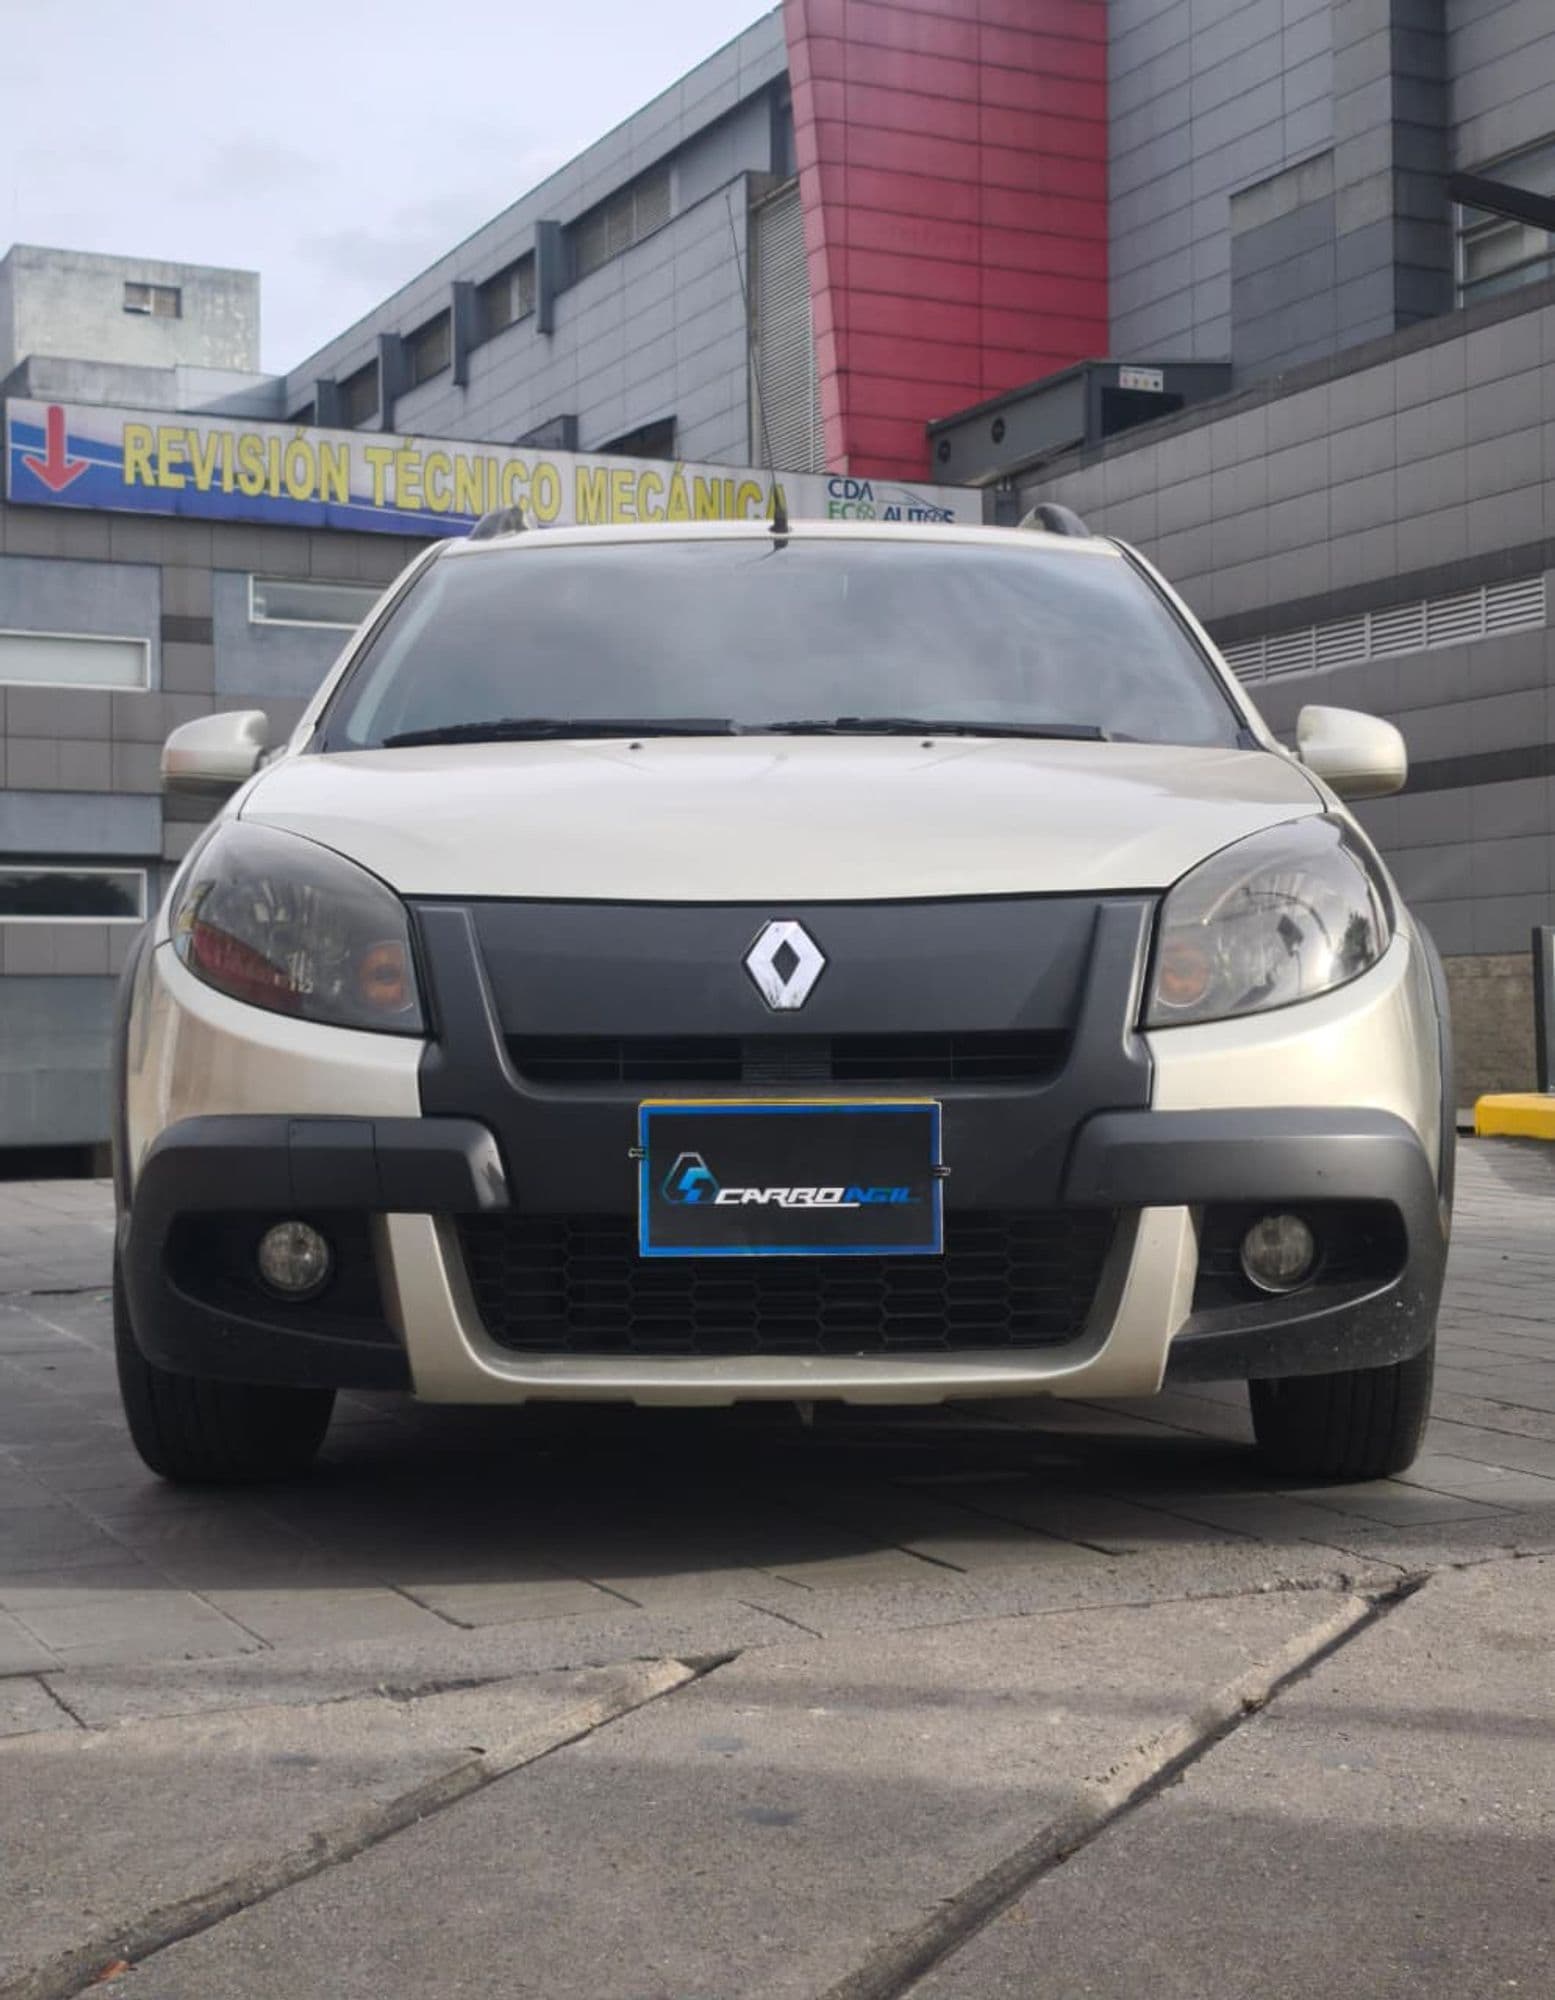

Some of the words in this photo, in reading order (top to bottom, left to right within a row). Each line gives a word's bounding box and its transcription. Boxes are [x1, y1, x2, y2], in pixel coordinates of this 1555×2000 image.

[122, 422, 351, 504] REVISIÓN
[364, 435, 562, 523] TÉCNICO
[574, 460, 788, 525] MECÁNICA
[827, 478, 875, 502] CDA
